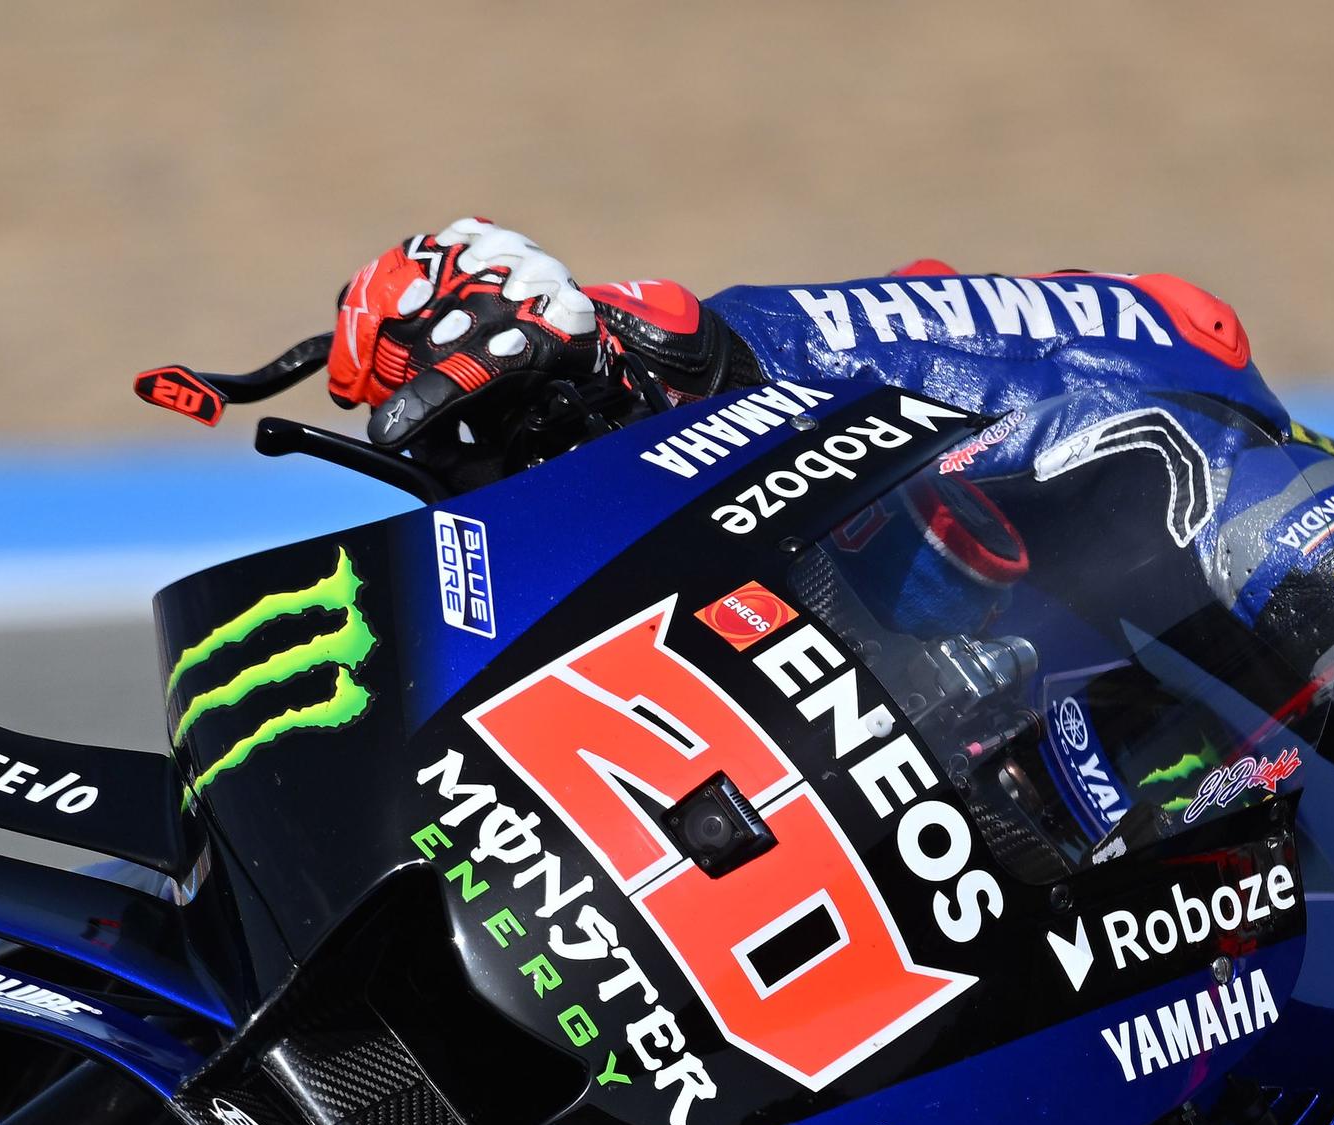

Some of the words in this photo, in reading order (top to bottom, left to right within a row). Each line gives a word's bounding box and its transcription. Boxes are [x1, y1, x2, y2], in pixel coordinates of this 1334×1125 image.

[789, 279, 1173, 351] YAMAHA
[152, 374, 204, 413] 20
[640, 380, 835, 478] YAMAHA
[711, 415, 913, 534] Roboze
[440, 524, 462, 614] CORE
[463, 529, 488, 622] BLUE
[723, 594, 771, 635] ENEOS
[752, 623, 1003, 942] ENEOS
[462, 593, 979, 1092] 20
[411, 823, 632, 1087] ENERGY
[1103, 864, 1296, 970] Roboze
[1101, 968, 1280, 1082] YAMAHA
